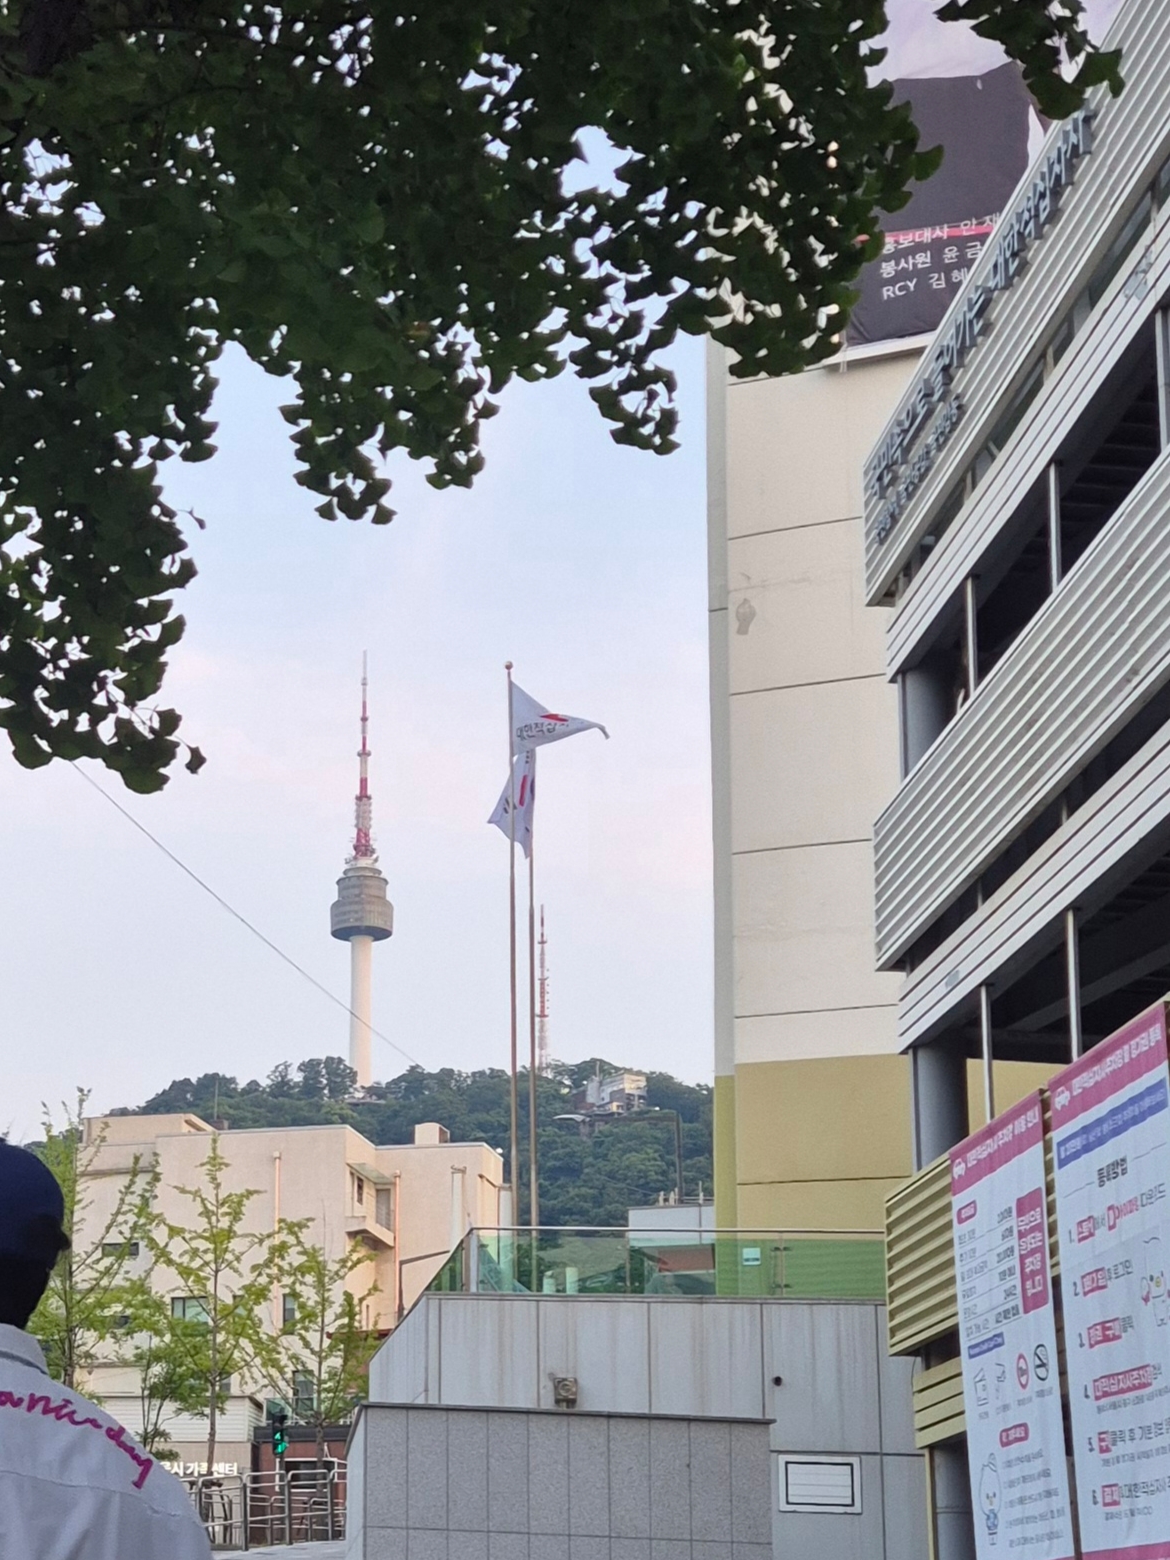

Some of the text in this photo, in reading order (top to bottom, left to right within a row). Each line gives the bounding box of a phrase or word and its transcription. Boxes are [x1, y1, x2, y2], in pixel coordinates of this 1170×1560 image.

[989, 106, 1092, 290] 대한적십자사
[879, 251, 932, 279] 봉사원
[882, 278, 917, 301] RCY
[516, 721, 569, 741] 대한적십
[105, 1425, 153, 1490] day
